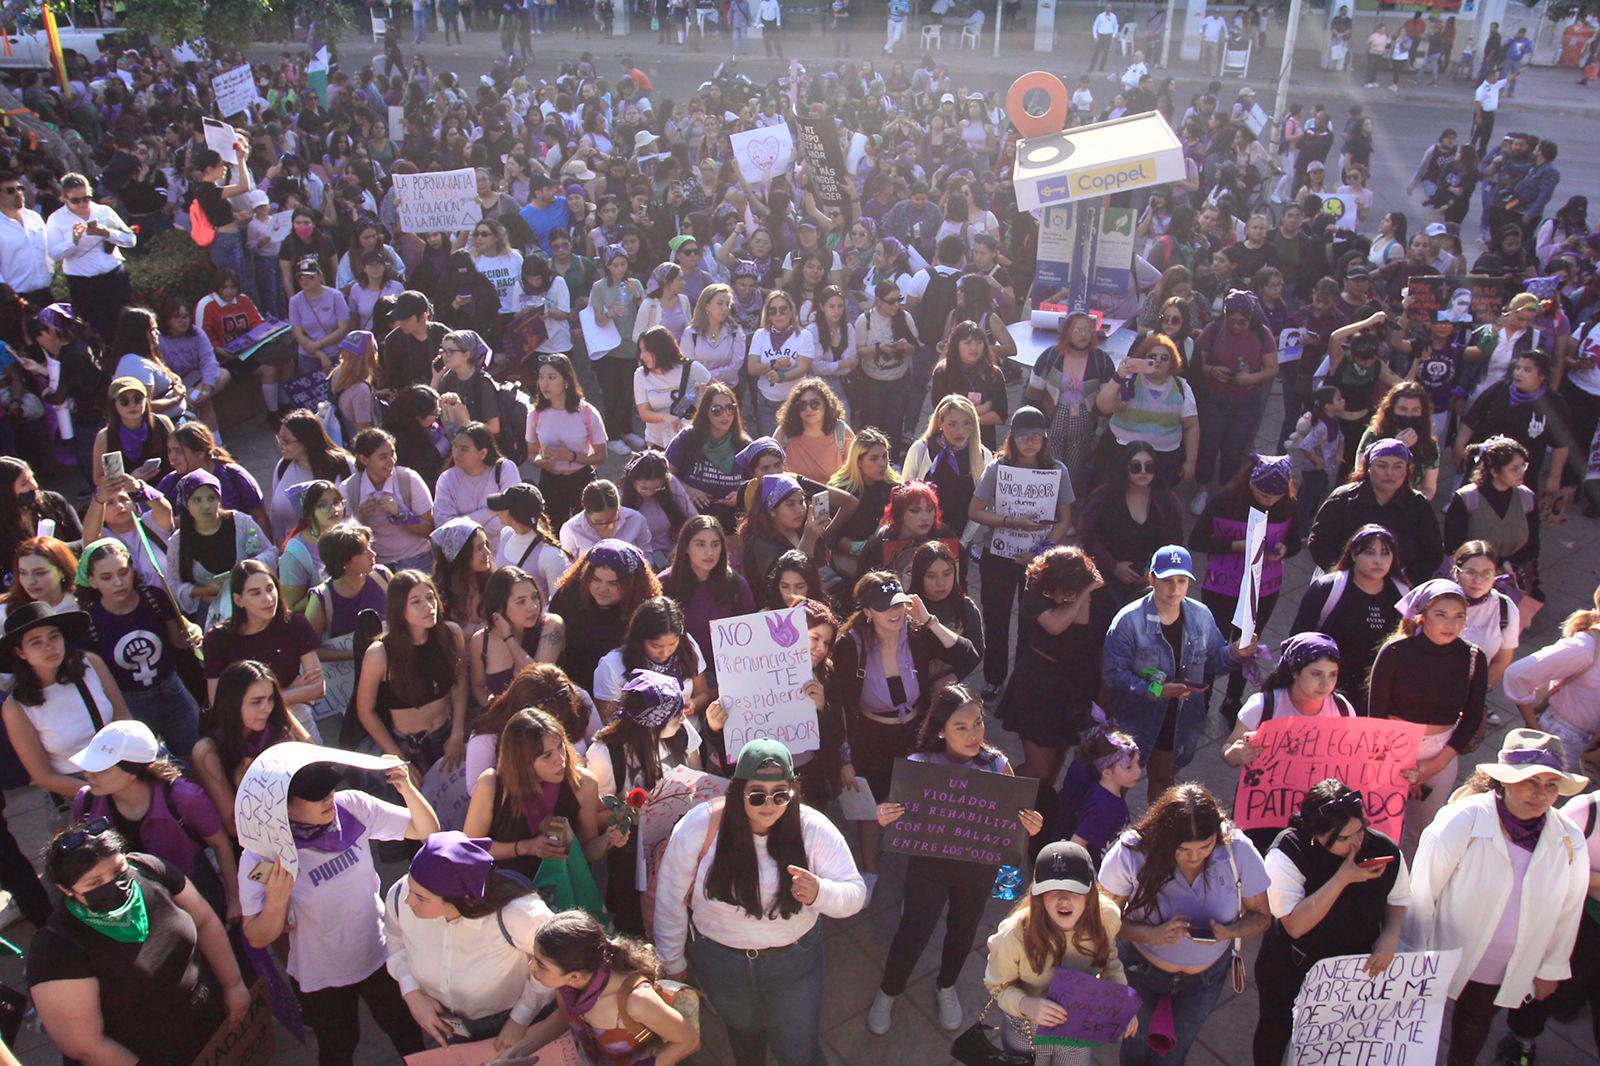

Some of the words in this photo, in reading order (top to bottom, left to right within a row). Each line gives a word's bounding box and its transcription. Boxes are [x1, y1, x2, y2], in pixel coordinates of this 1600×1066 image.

[1078, 164, 1146, 190] Coppel
[764, 348, 798, 360] KARL
[999, 483, 1055, 499] VIOLADOR
[1170, 550, 1182, 564] LA
[718, 622, 753, 648] NO
[767, 666, 799, 686] TE
[948, 779, 968, 790] UN
[923, 789, 998, 811] VIOLADOR
[904, 802, 920, 812] SE
[928, 806, 1018, 831] REHABILITA
[895, 821, 921, 833] CON
[927, 824, 946, 834] UN
[954, 827, 1011, 847] BALAZO
[892, 838, 938, 853] ENTRE
[942, 845, 965, 855] LOS
[308, 848, 360, 887] PUMA
[1411, 954, 1441, 978] UN
[1357, 977, 1396, 1001] QUE
[1403, 975, 1438, 1000] ME
[1377, 997, 1426, 1021] UNA
[1347, 1019, 1386, 1042] QUE
[1393, 1019, 1427, 1045] ME
